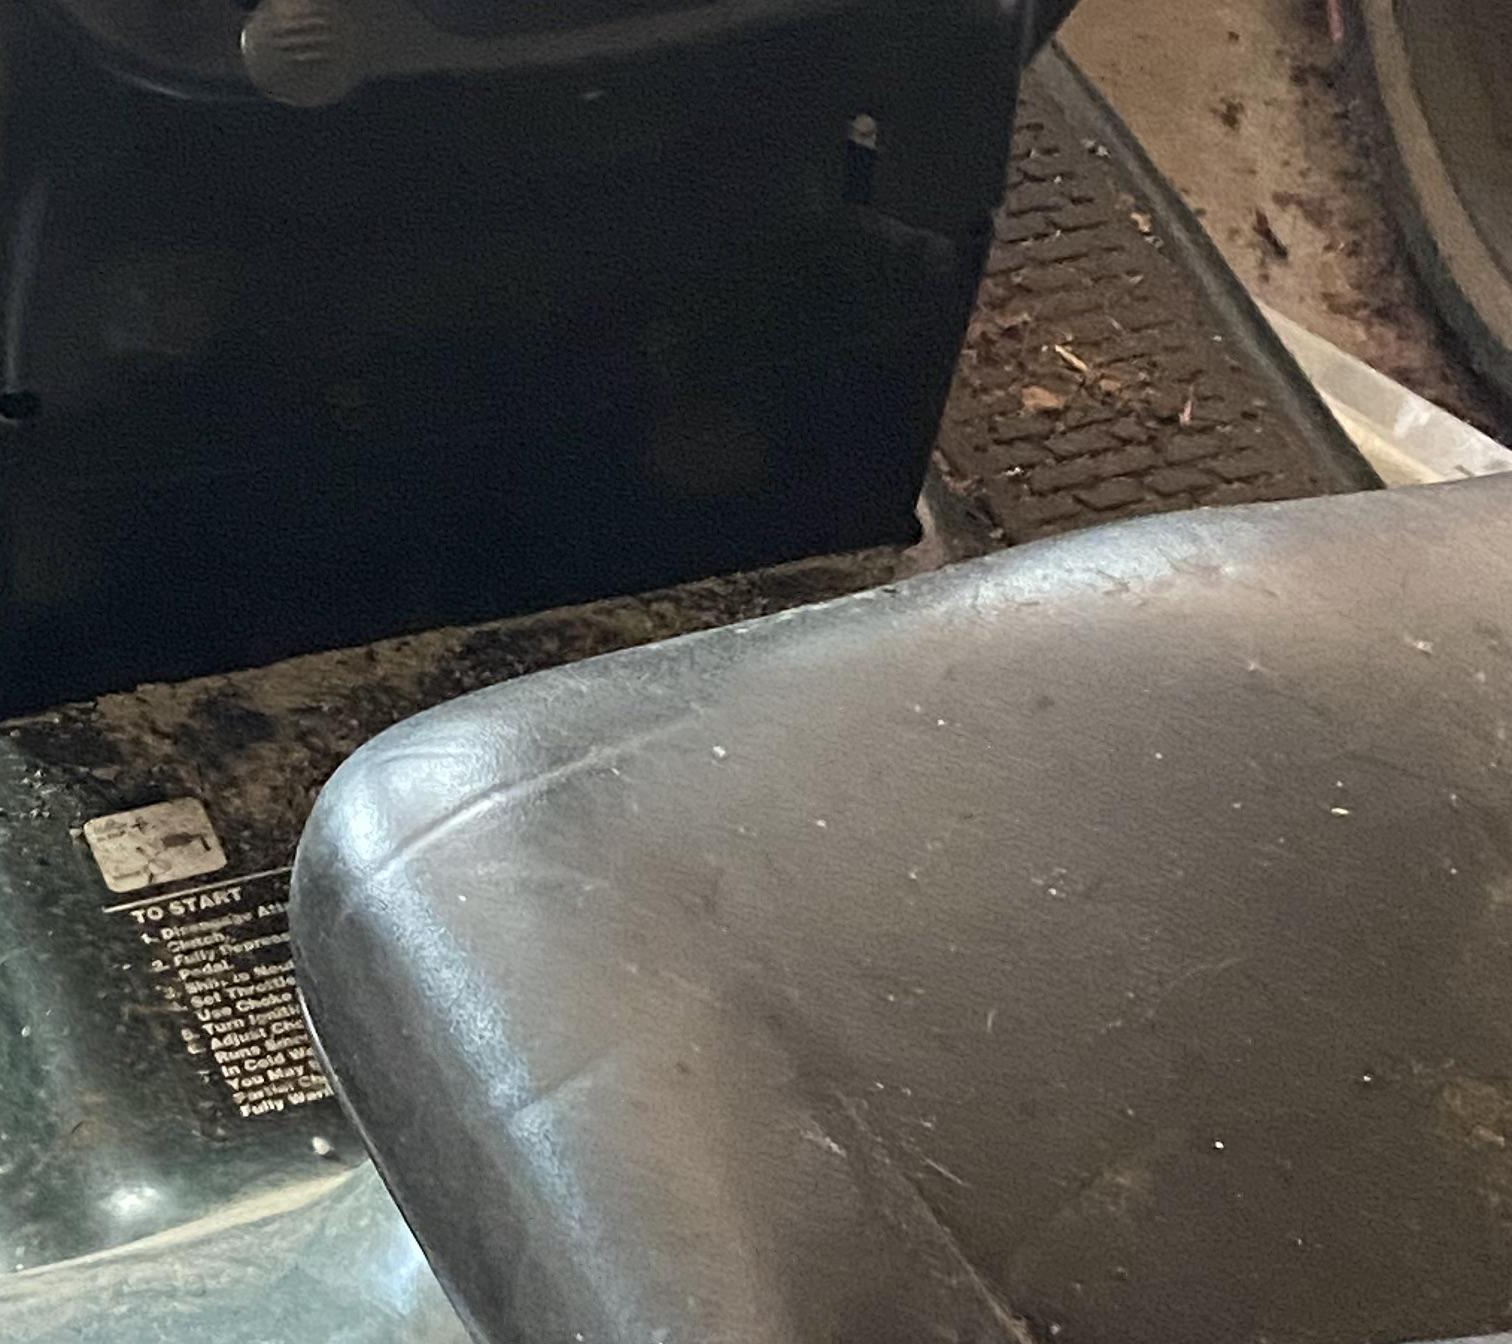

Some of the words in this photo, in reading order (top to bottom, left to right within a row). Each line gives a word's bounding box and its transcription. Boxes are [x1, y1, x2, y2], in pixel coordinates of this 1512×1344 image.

[130, 905, 165, 924] TO
[169, 886, 243, 916] START
[201, 1018, 246, 1036] Turn
[244, 1052, 287, 1071] Cold
[224, 1074, 265, 1092] You
[266, 1064, 305, 1082] May
